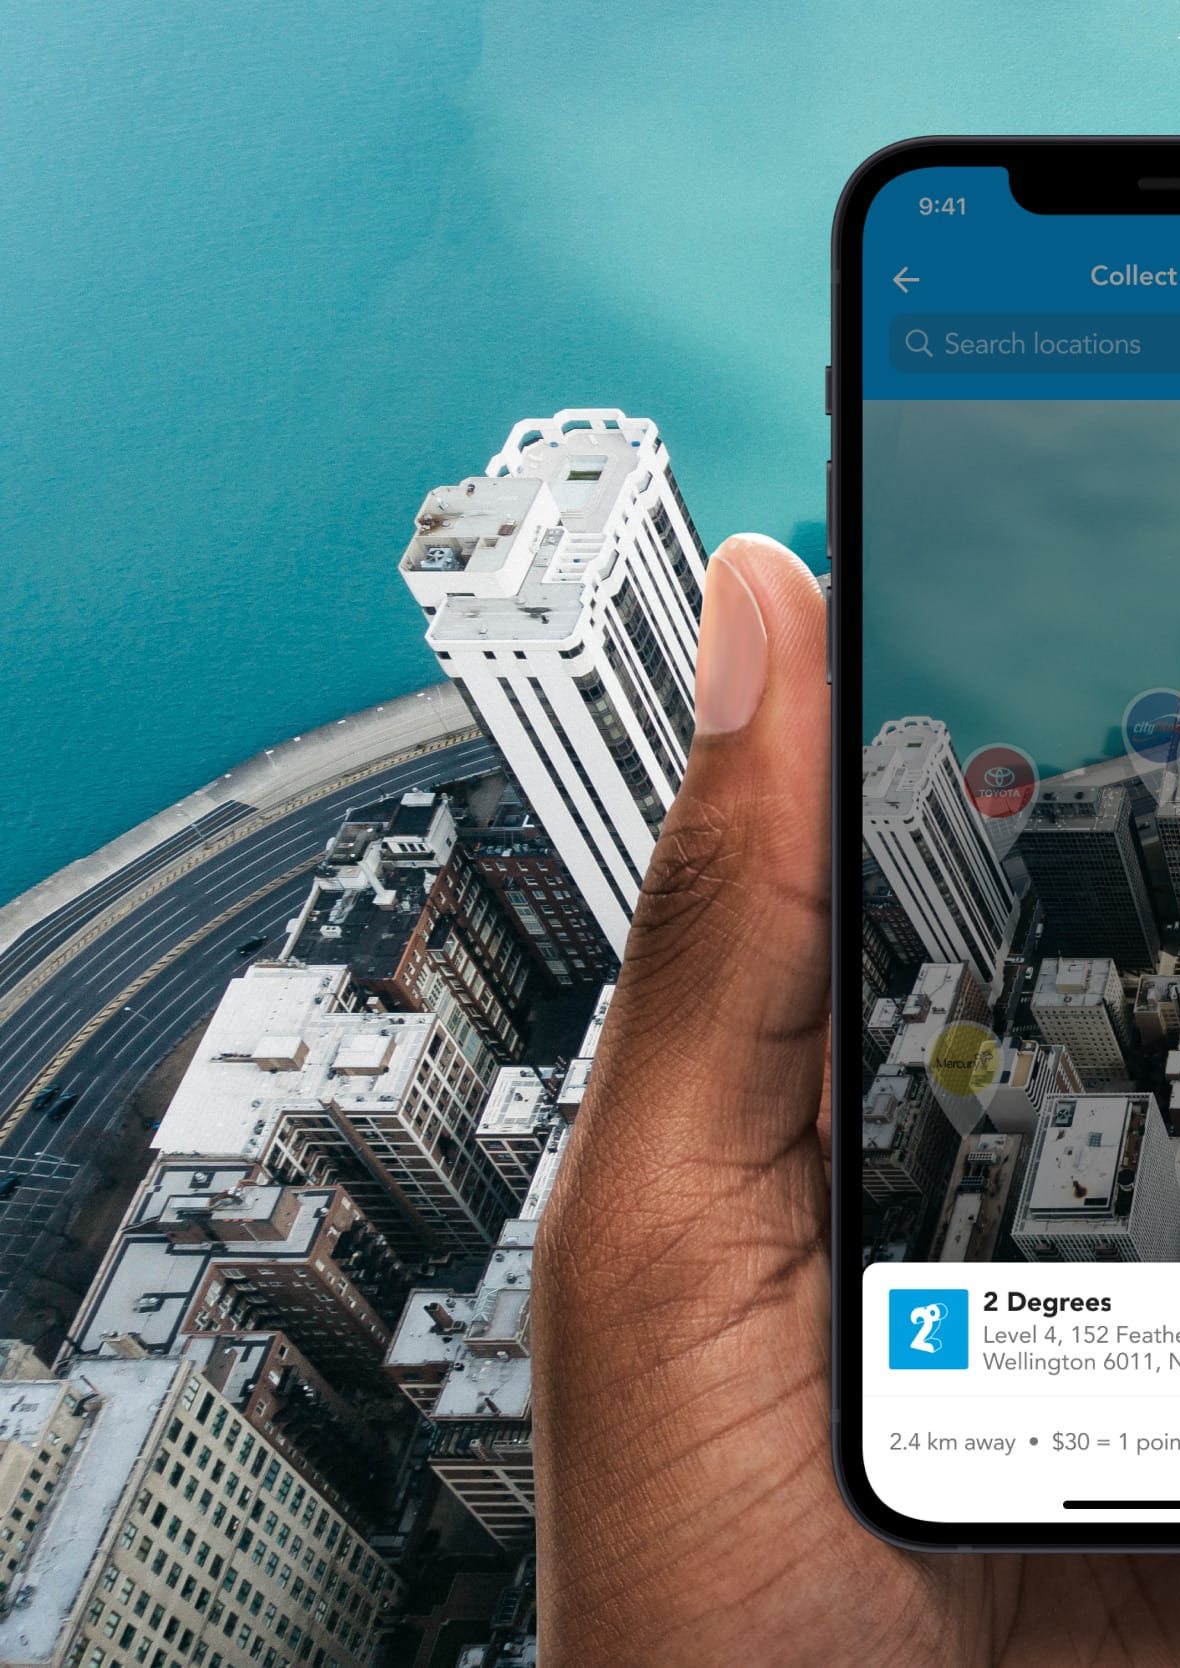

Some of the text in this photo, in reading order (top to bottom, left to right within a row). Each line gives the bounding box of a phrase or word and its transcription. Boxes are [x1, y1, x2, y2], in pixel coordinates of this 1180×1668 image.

[919, 197, 965, 215] 9:41
[1091, 264, 1177, 286] Collect
[945, 331, 1141, 354] Search locations
[979, 789, 1021, 798] TOYOTA
[936, 1057, 980, 1071] Mercury
[984, 1291, 1112, 1318] 2 Degrees
[984, 1325, 1037, 1344] Level
[1043, 1325, 1063, 1347] 4,
[1072, 1325, 1109, 1344] 152
[983, 1352, 1096, 1376] Wellington
[1104, 1352, 1161, 1374] 6011,
[889, 1433, 921, 1451] 2.4
[928, 1432, 958, 1451] km
[964, 1437, 1016, 1456] away
[1052, 1431, 1090, 1452] $30
[1119, 1433, 1127, 1451] 1
